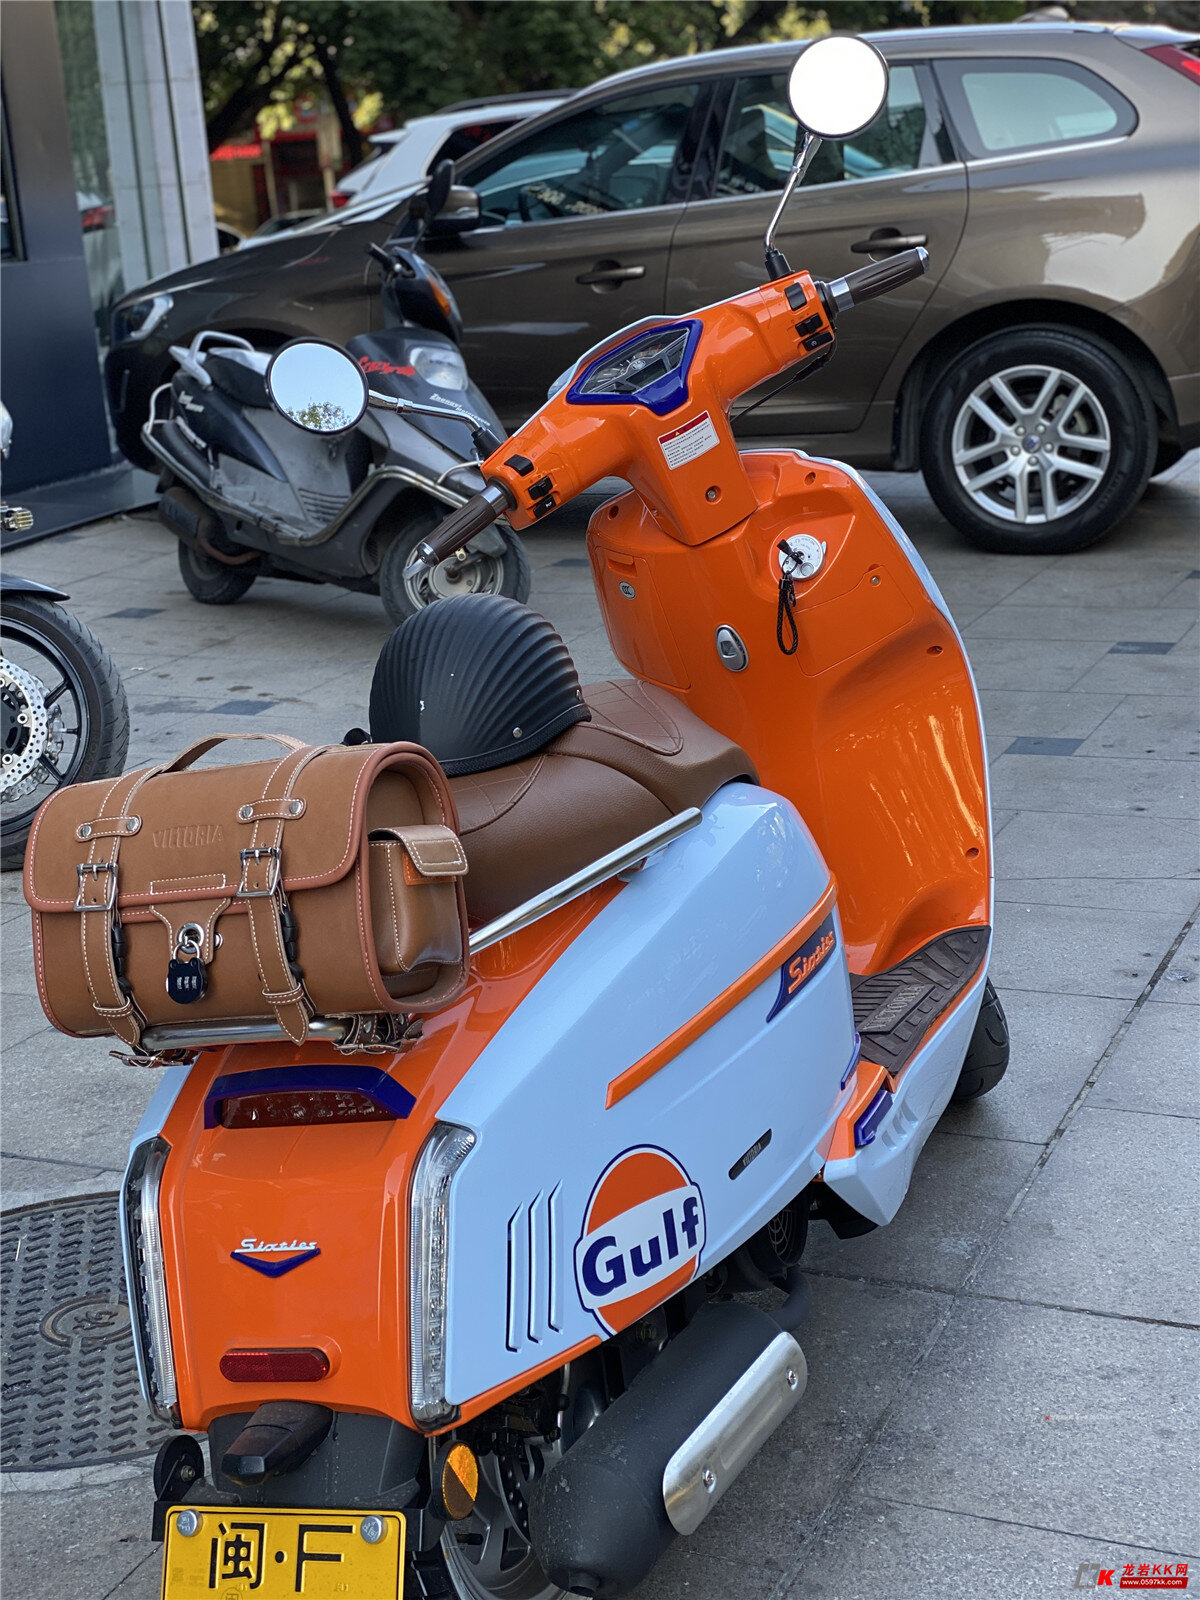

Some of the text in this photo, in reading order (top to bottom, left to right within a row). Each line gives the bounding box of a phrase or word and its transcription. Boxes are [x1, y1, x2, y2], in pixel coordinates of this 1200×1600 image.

[862, 985, 926, 1030] VICTORIA
[235, 1238, 317, 1253] Sixties
[582, 1196, 699, 1297] Gulf
